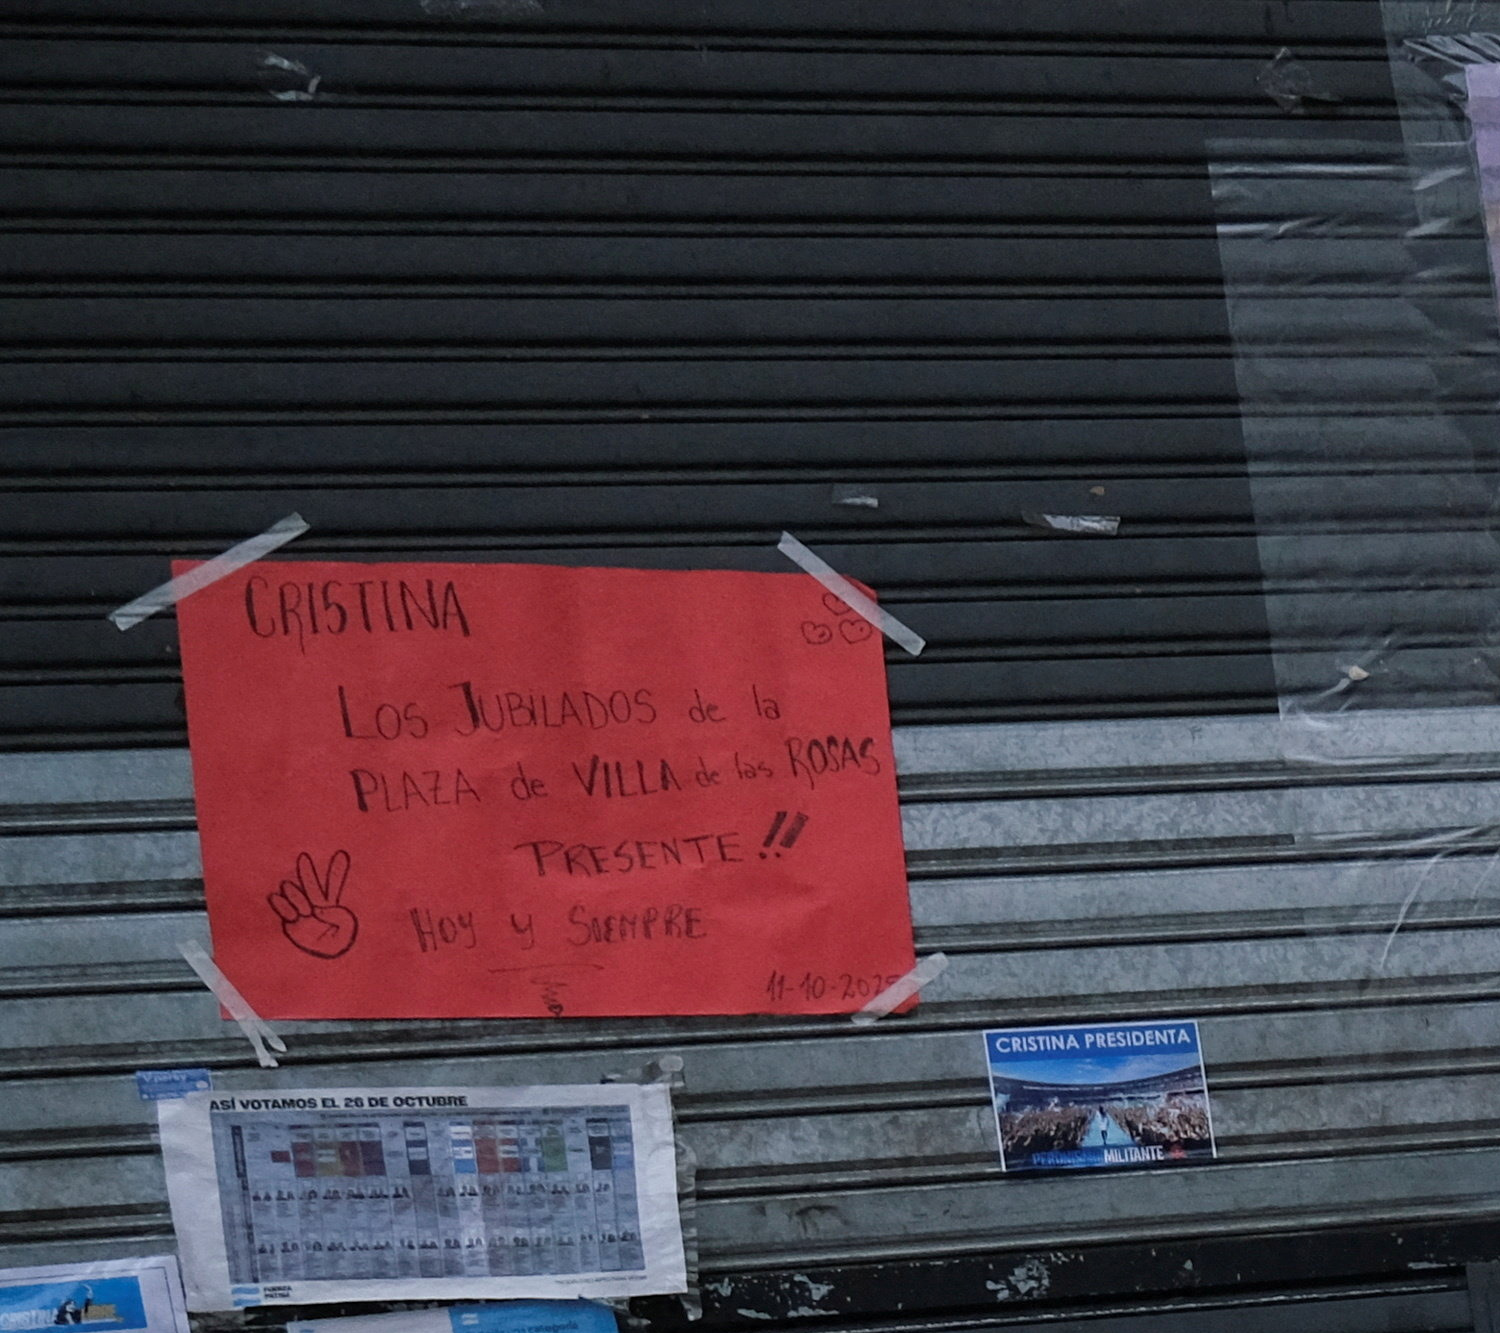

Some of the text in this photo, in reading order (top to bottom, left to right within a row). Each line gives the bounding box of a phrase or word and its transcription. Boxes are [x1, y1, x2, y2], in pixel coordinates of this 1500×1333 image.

[244, 575, 470, 655] CRISTINA
[688, 689, 727, 723] de
[752, 684, 781, 721] la
[349, 735, 881, 813] PLAZA de VILLA de las ROSAS
[513, 832, 744, 877] PRESENTE
[567, 905, 708, 946] SIEMPRE
[996, 1029, 1191, 1053] CRISTINA PRESIDENTA
[209, 1094, 468, 1111] ASÍ VOTAMOS EL 26 DE OCTUBRE
[1104, 1145, 1164, 1163] MILITANTE
